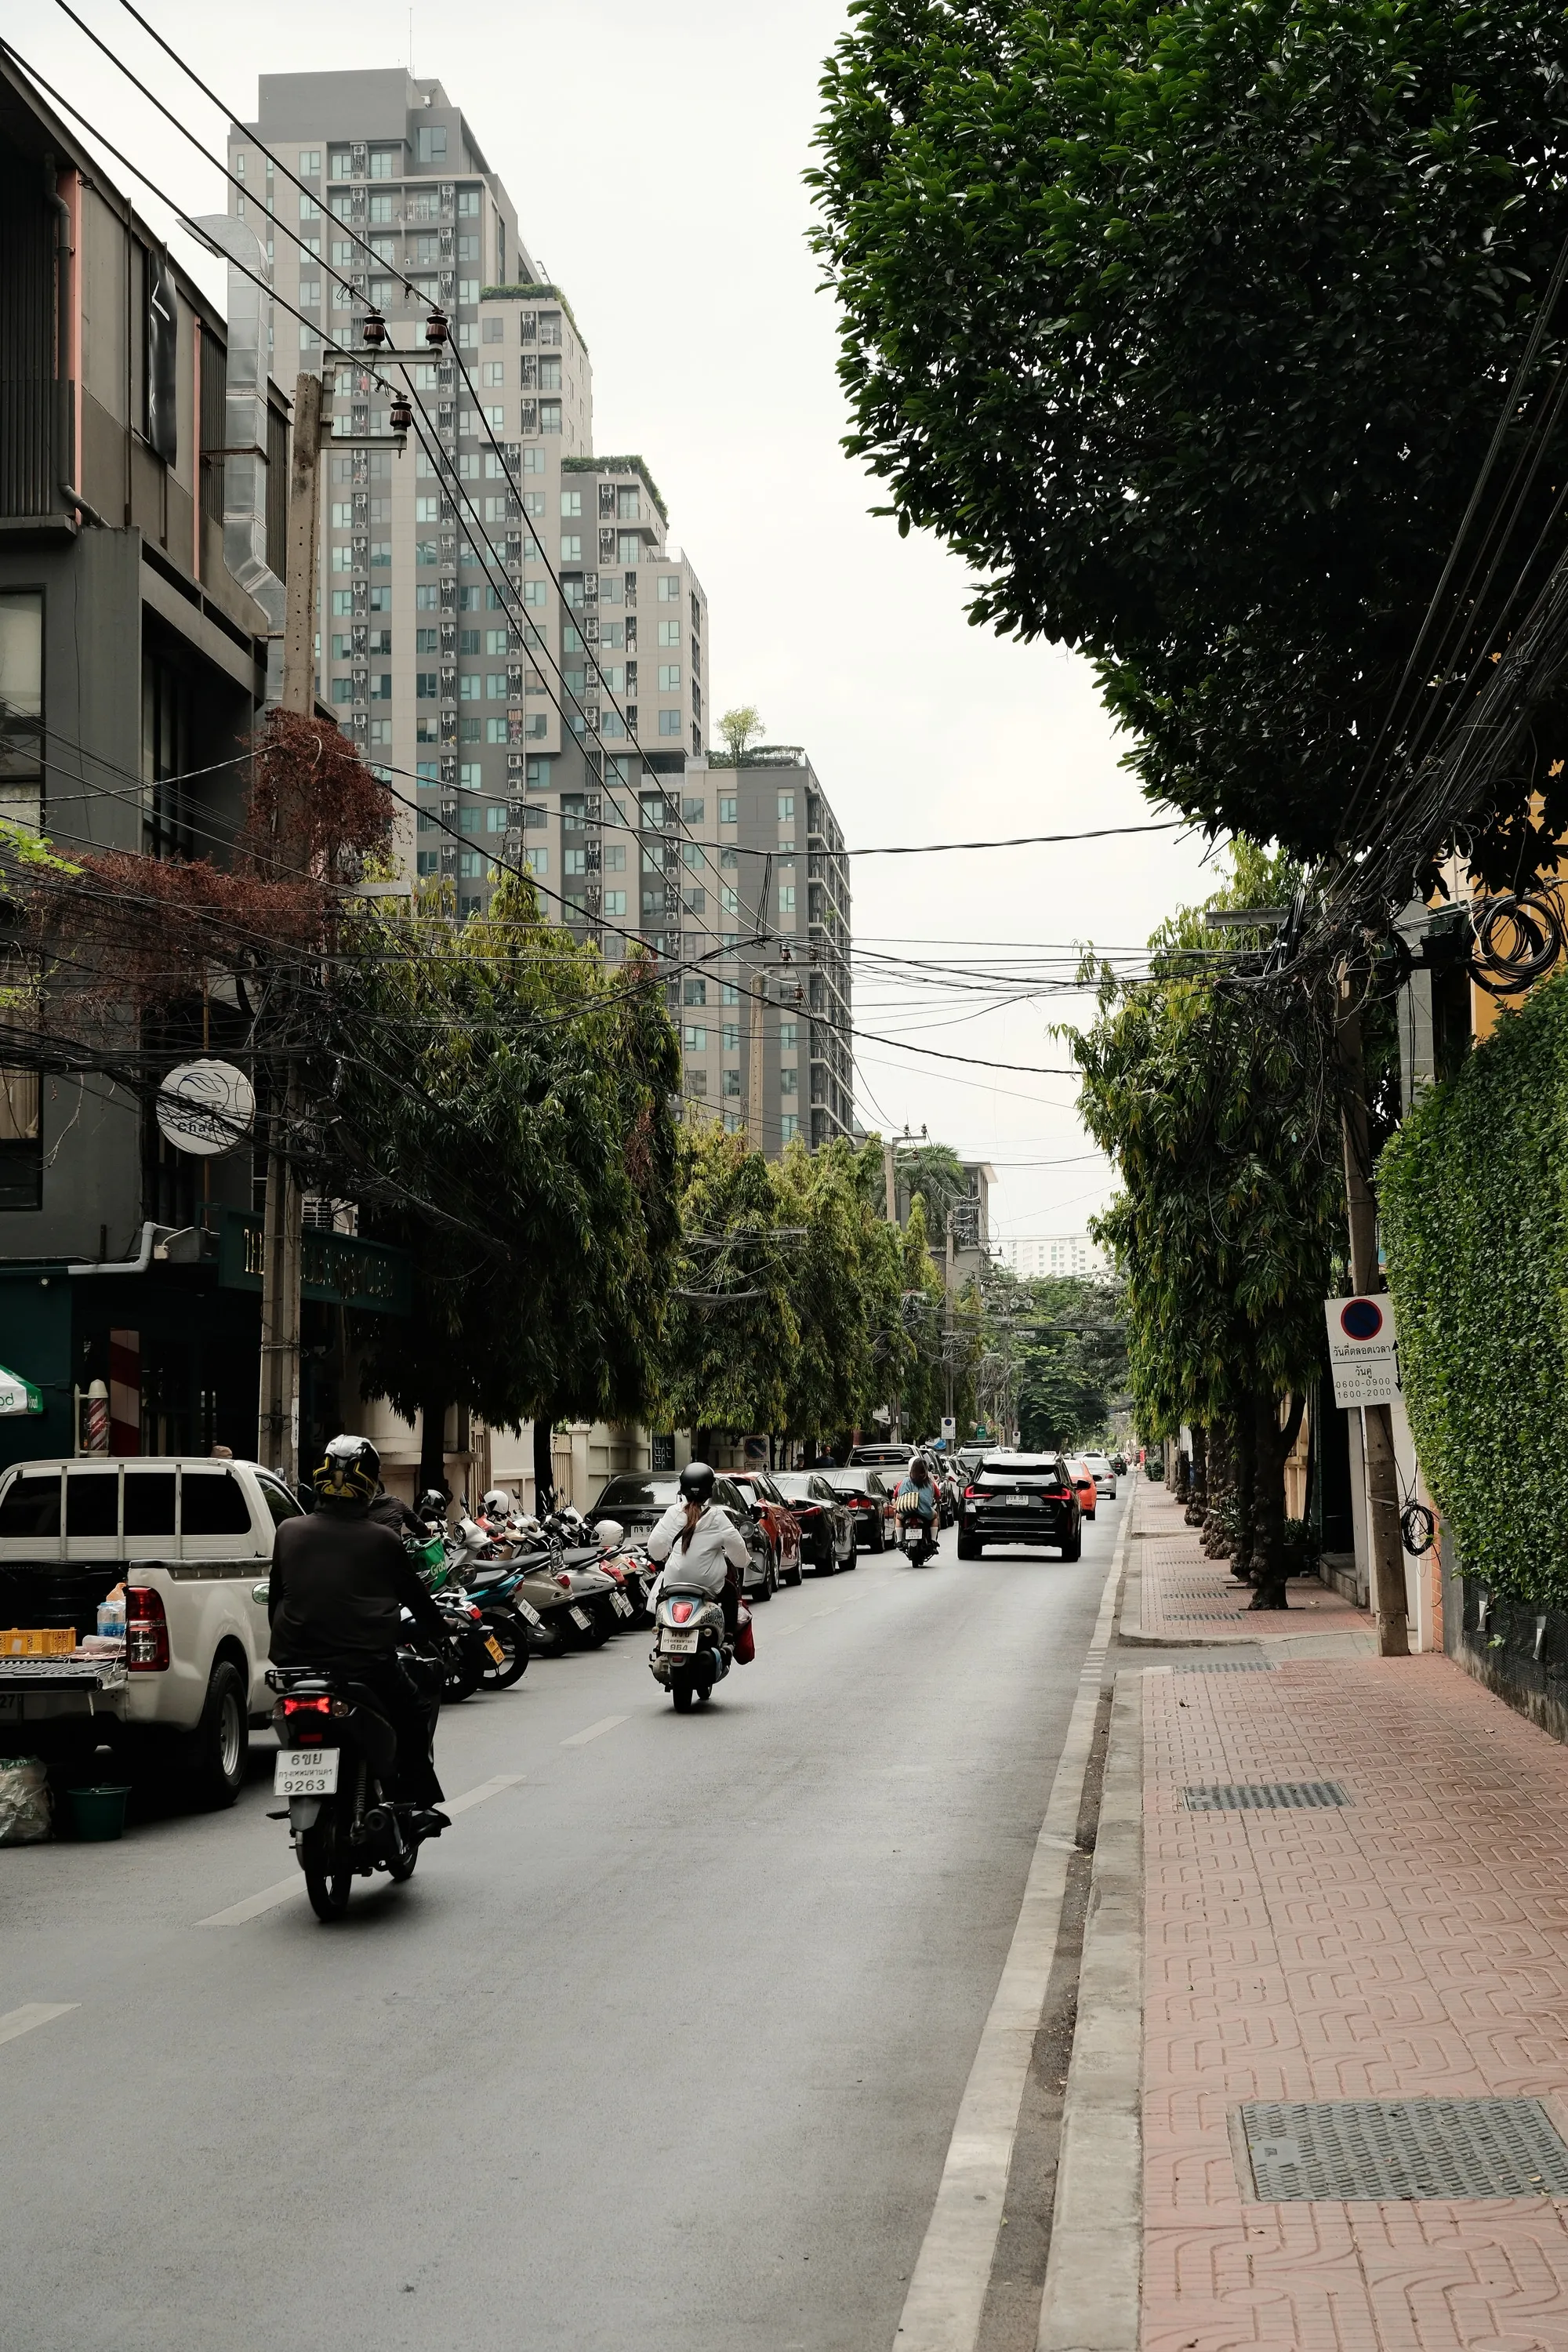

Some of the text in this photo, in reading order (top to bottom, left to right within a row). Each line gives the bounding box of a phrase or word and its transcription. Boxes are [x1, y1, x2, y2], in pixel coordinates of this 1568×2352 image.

[1333, 1343, 1391, 1357] วันคี่ตลอดเวลา
[1355, 1365, 1373, 1378] วันคู่
[1336, 1377, 1390, 1388] 0600-0900
[1338, 1388, 1392, 1399] 1600-2000
[430, 1559, 446, 1576] Grab
[291, 1753, 322, 1766] 6ขย
[278, 1768, 333, 1779] กรุงเทพมหานคร
[284, 1779, 325, 1792] 9263
